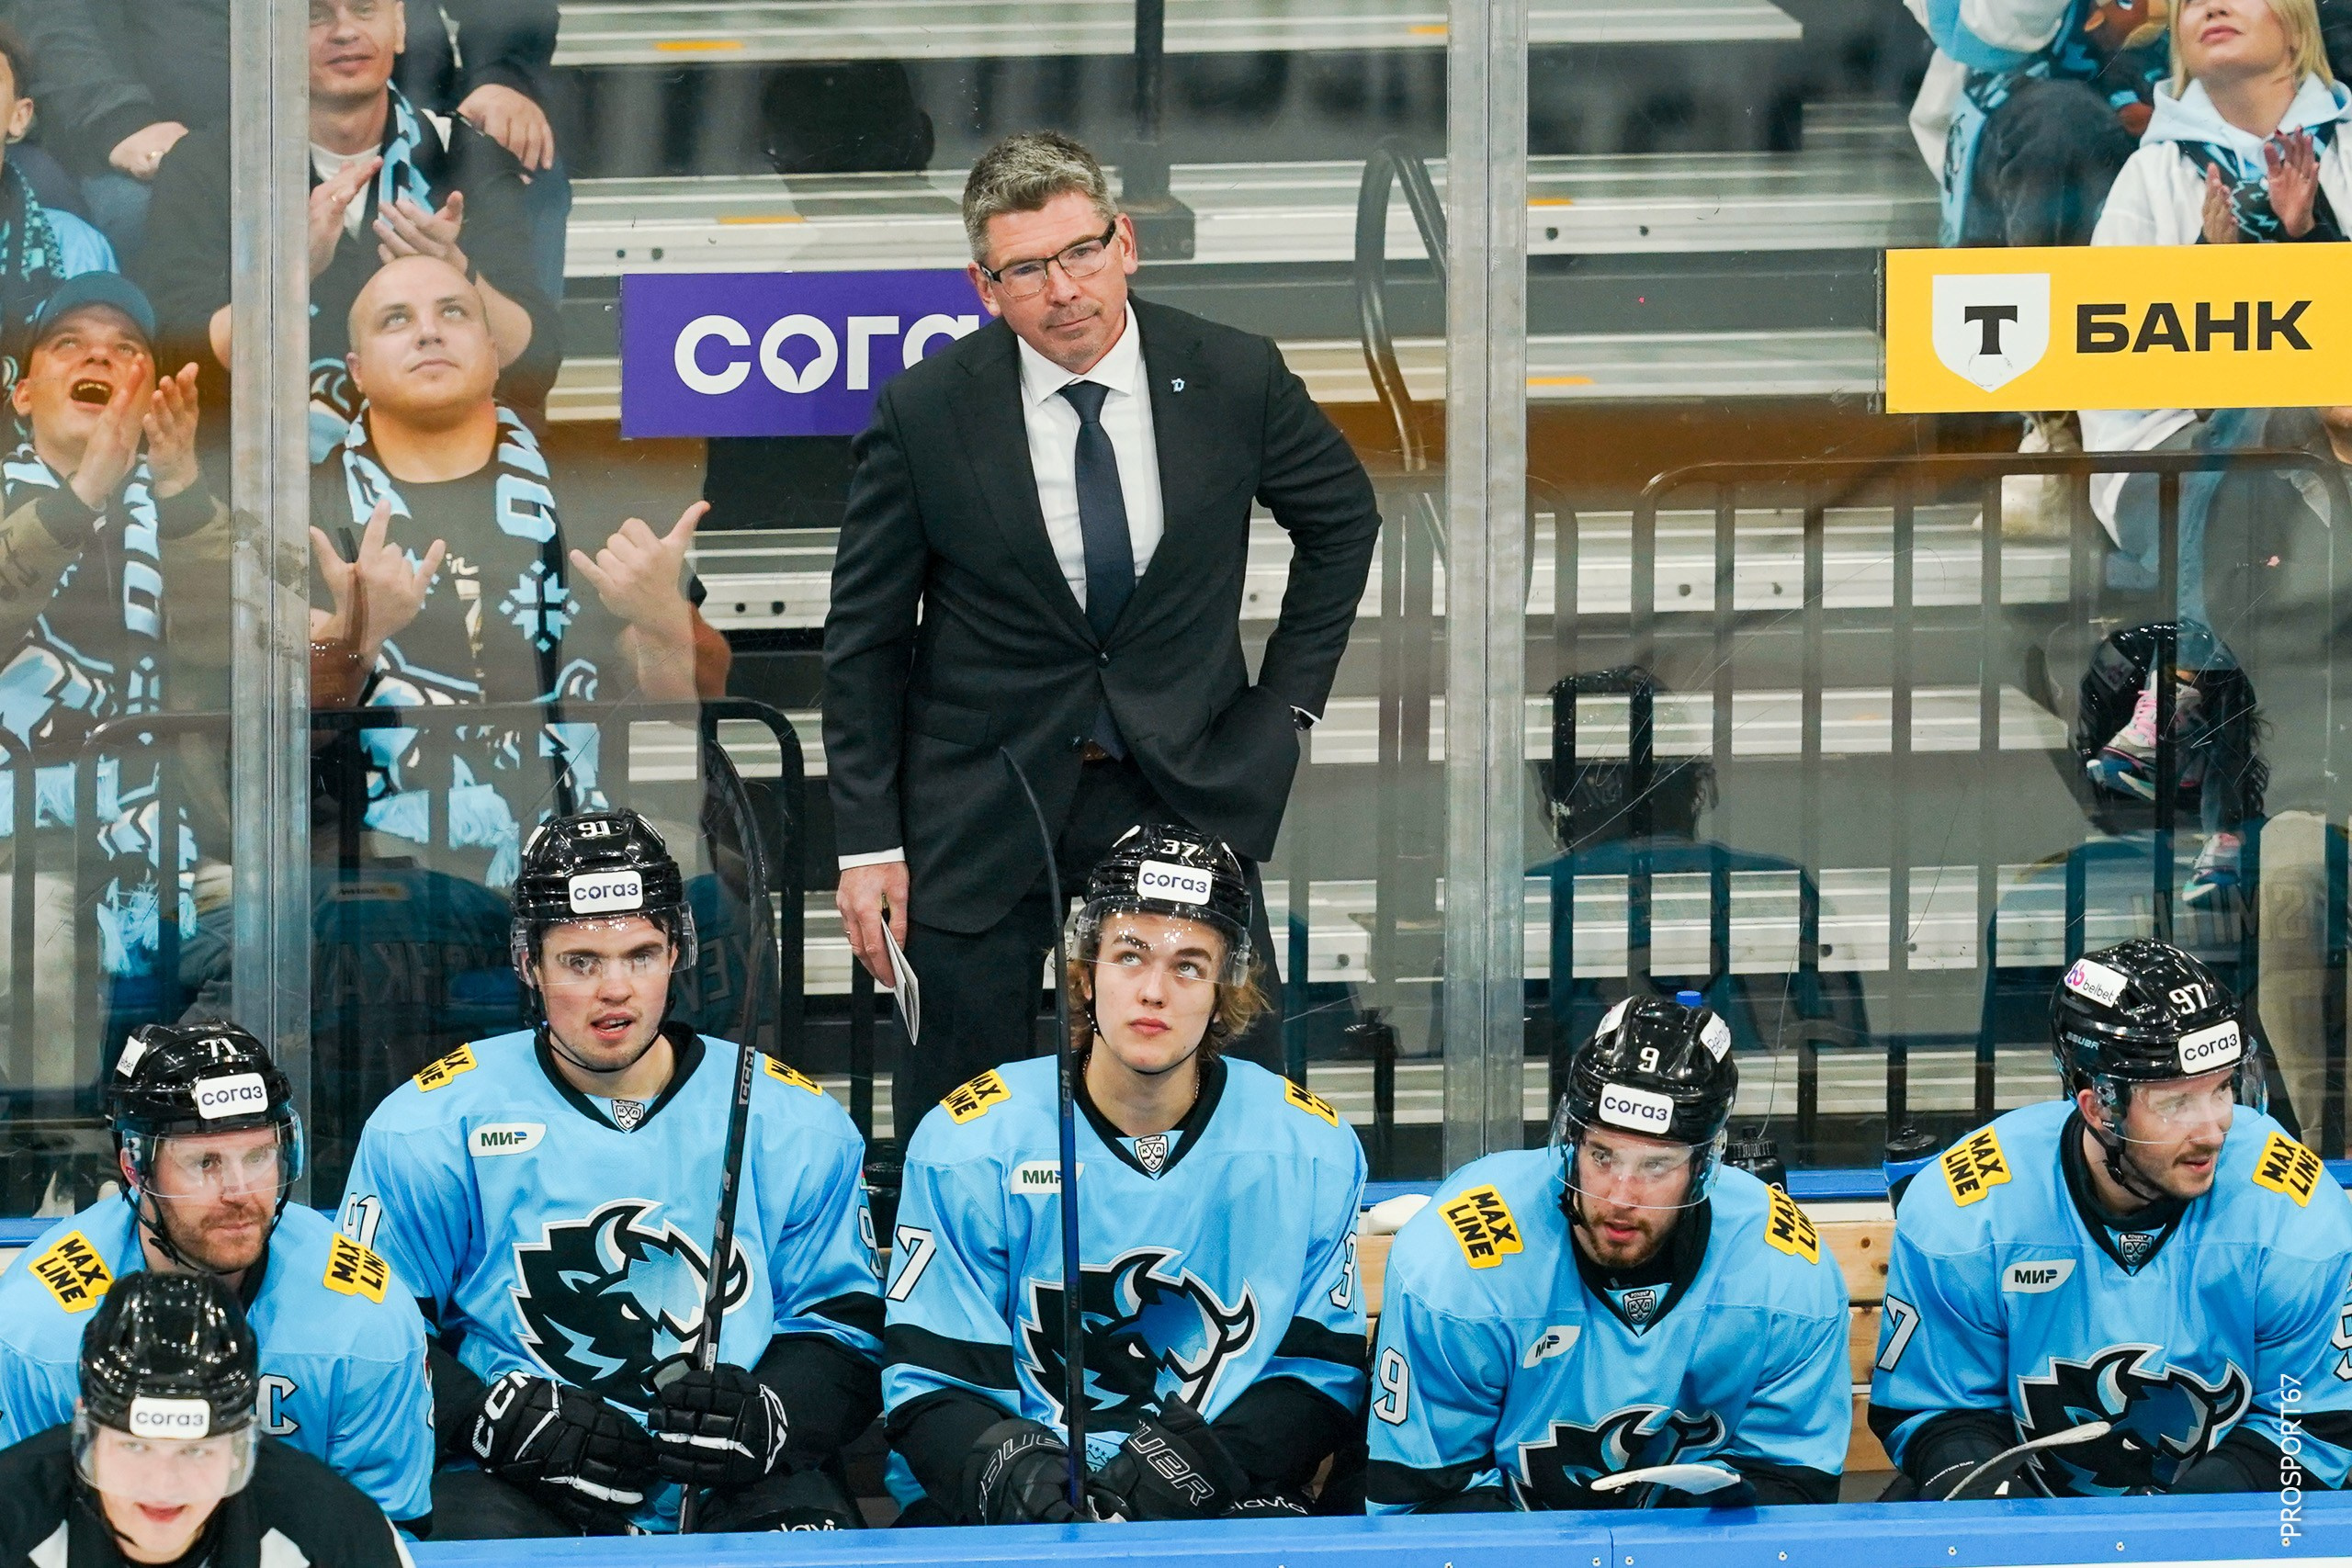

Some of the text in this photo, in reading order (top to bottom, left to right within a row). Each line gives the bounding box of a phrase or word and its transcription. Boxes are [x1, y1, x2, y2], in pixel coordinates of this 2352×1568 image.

[2076, 300, 2313, 355] БАНК
[673, 313, 980, 395] сога
[577, 820, 611, 838] 91
[1159, 839, 1200, 866] 37
[573, 882, 639, 901] согаз
[1142, 872, 1208, 894] согаз
[2082, 977, 2115, 1003] belbet
[2168, 983, 2209, 1015] 97
[1637, 1046, 1660, 1073] 9
[2184, 1033, 2238, 1061] согаз
[201, 1085, 264, 1106] согаз
[741, 1050, 755, 1101] CCM
[1604, 1096, 1668, 1122] согаз
[481, 1131, 527, 1147] МИР
[1970, 1132, 2006, 1179] MAX
[2261, 1136, 2297, 1185] MAX
[1945, 1148, 1980, 1197] LINE
[2289, 1148, 2320, 1197] LINE
[1446, 1203, 1496, 1259] LINE
[1469, 1190, 1518, 1246] MAX
[1771, 1191, 1796, 1245] MAX
[1792, 1198, 1816, 1252] LIN
[35, 1257, 88, 1304] LINE
[57, 1237, 109, 1288] MAX
[331, 1238, 361, 1285] MAX
[1328, 1231, 1358, 1315] 3
[2014, 1269, 2058, 1284] МИР
[1535, 1335, 1560, 1359] МР
[255, 1372, 301, 1436] C
[1373, 1346, 1410, 1427] 9
[136, 1411, 204, 1427] согаз
[1128, 1419, 1216, 1506] UER
